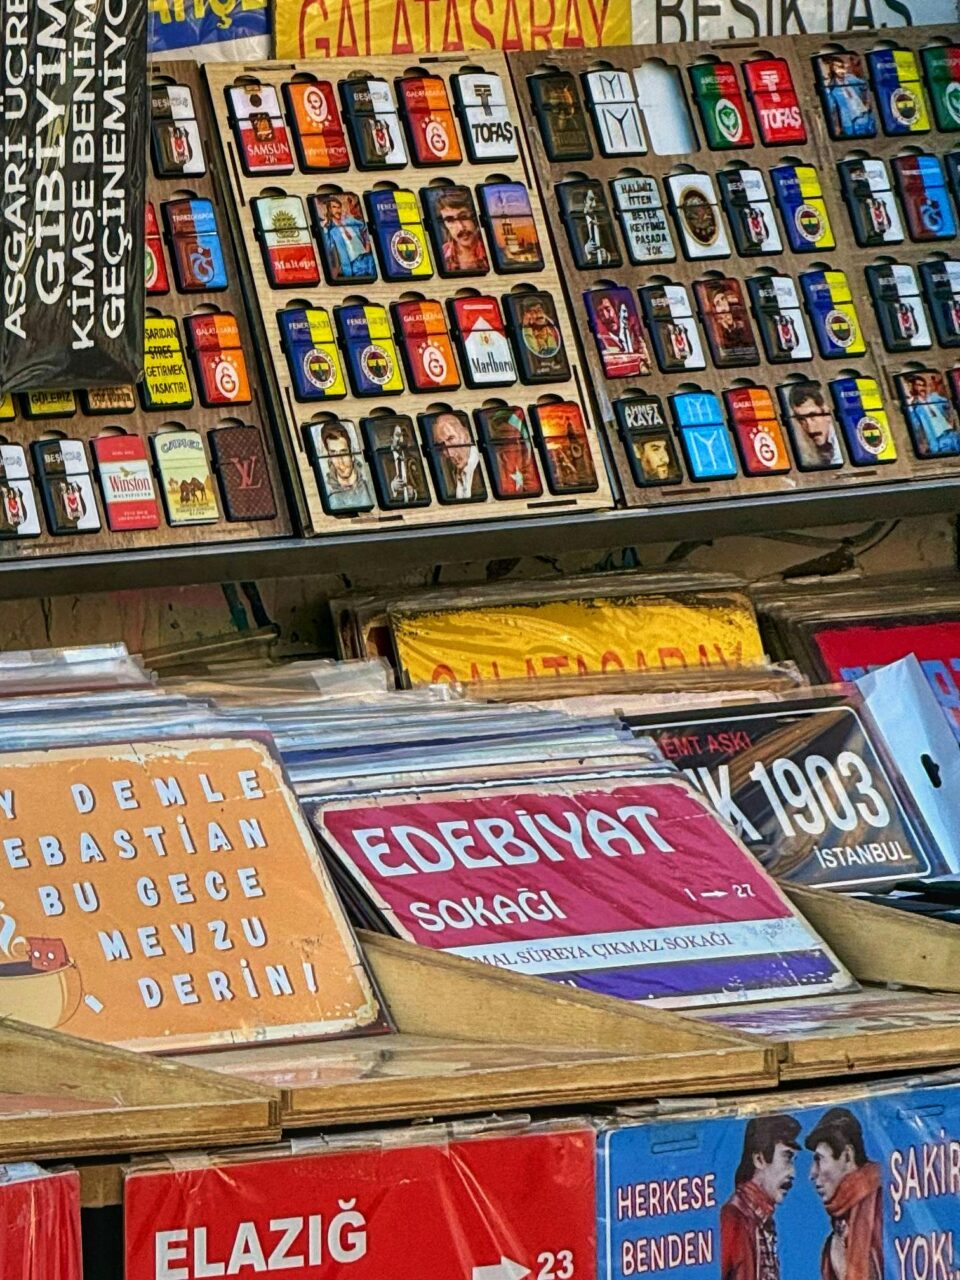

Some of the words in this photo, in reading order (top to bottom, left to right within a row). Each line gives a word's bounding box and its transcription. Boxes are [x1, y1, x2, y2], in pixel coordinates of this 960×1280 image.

[471, 121, 514, 144] TOFAŞ
[760, 106, 802, 130] TOFAŞ
[247, 142, 290, 156] SAMSUN
[63, 170, 96, 351] KİMSE
[471, 352, 514, 374] Marlboro
[624, 404, 659, 417] AHMET
[626, 412, 664, 428] KAYA
[160, 437, 204, 453] CAMEL
[108, 470, 152, 494] Winston
[70, 769, 268, 816] DEMLE
[748, 750, 891, 838] 1903
[351, 804, 677, 879] EDEBİYAT
[814, 839, 913, 870] İSTANBUL
[38, 881, 101, 918] BU
[136, 865, 265, 909] GECE
[410, 883, 569, 933] SOKAĞI
[97, 916, 269, 962] MEVZU
[471, 950, 517, 968] MAL
[516, 943, 592, 965] SÜREYA
[591, 938, 665, 960] ÇIKMAZ
[662, 929, 734, 952] SOKAĞI
[616, 1173, 717, 1221] HERKESE
[155, 1197, 368, 1280] ELAZIĞ
[621, 1230, 714, 1277] BENDEN
